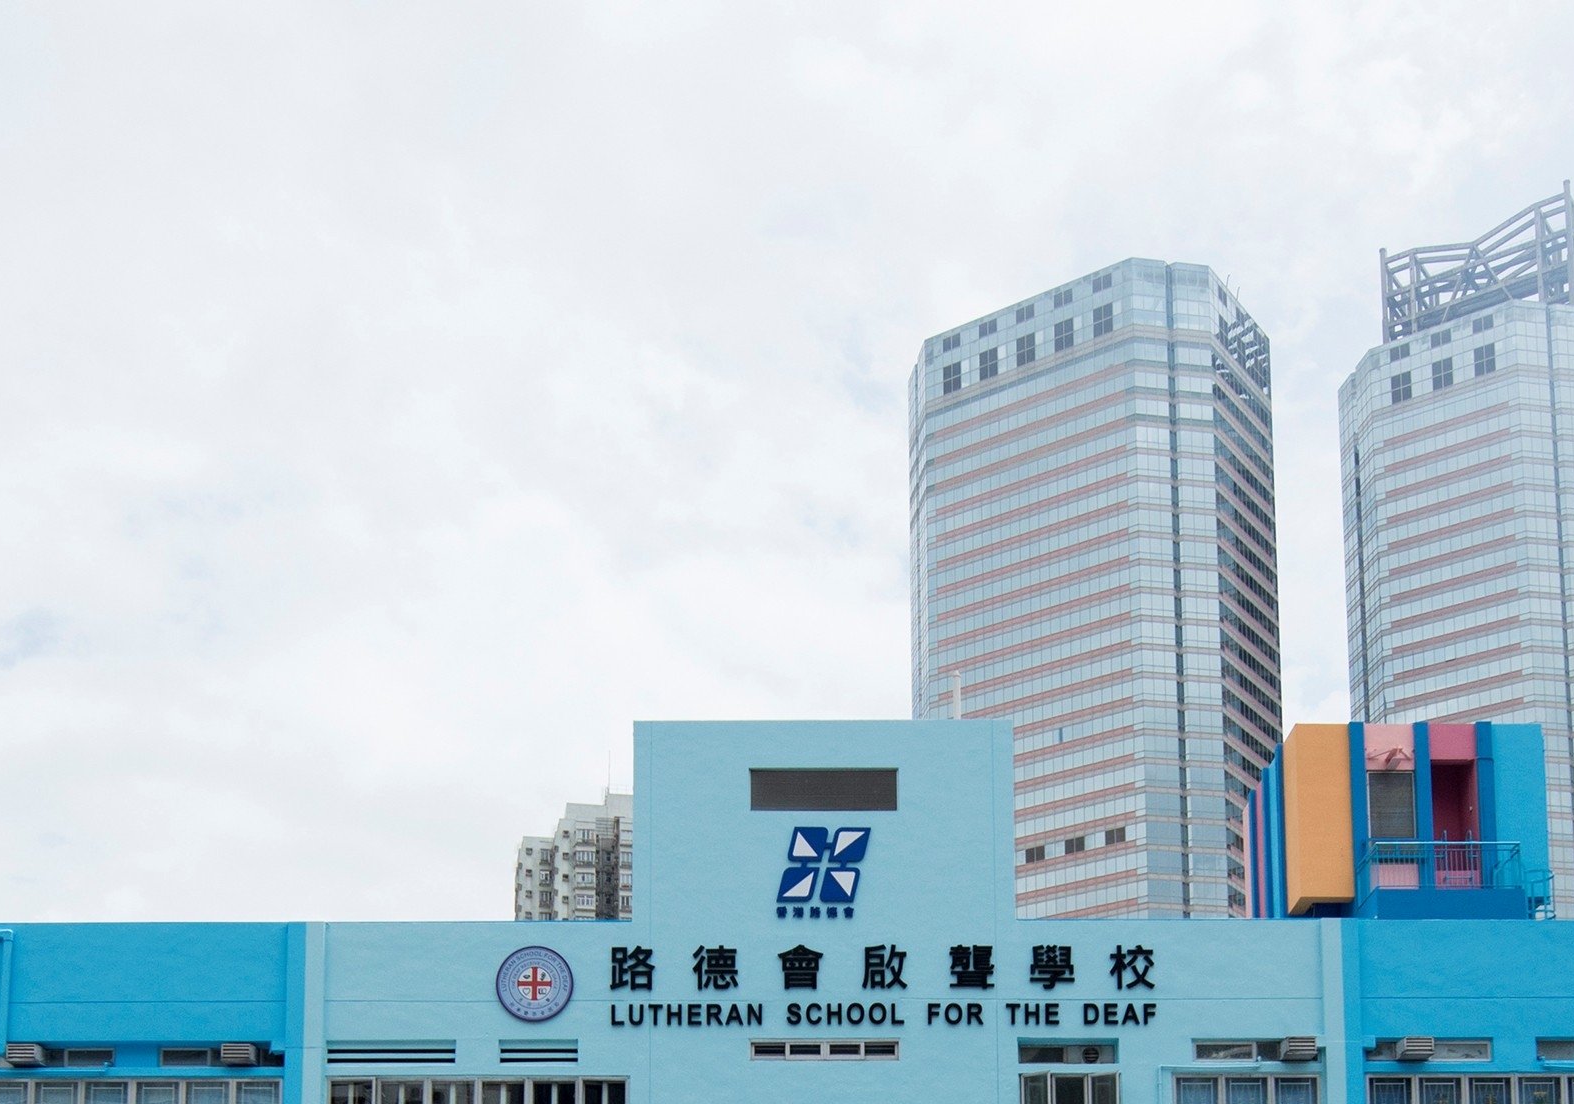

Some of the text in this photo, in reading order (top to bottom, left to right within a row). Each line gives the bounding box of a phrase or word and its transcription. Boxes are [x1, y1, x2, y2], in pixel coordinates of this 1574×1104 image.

[609, 944, 1155, 992] 路德會啟聾學校
[611, 1002, 1157, 1027] LUTHERAN SCHOOL FOR THE DEAF
